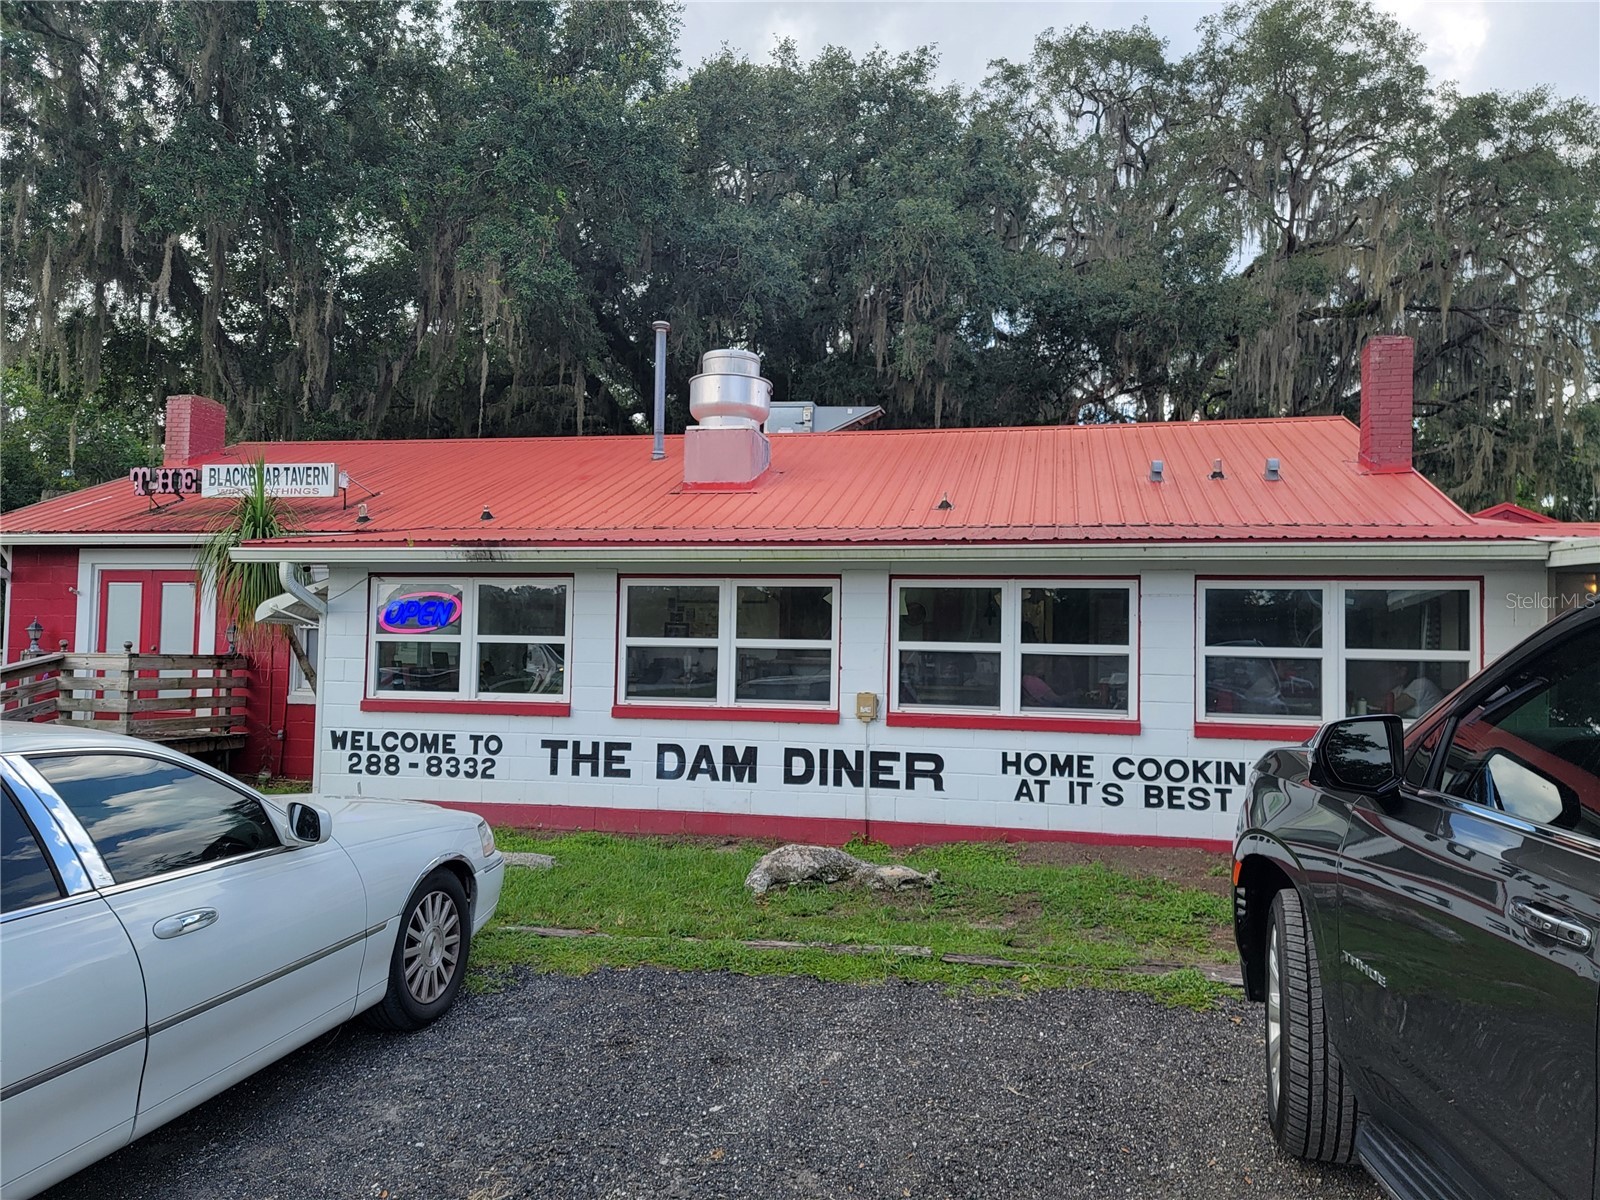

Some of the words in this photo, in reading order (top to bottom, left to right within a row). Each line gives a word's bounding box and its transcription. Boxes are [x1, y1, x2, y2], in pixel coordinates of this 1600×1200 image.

[129, 467, 197, 496] THE
[208, 467, 280, 487] BLACKBAR
[284, 466, 329, 486] TAVERN
[276, 486, 320, 495] THINGS
[384, 600, 454, 627] OPEN
[330, 730, 456, 754] WELCOME
[469, 734, 503, 756] TO
[540, 739, 632, 779] THE
[656, 743, 758, 784] DAM
[783, 747, 945, 792] DINER
[1001, 751, 1094, 779] HOME
[1112, 756, 1252, 786] COOKIN'
[1014, 779, 1050, 803] AT
[1068, 780, 1124, 807] IT'S
[1144, 785, 1232, 812] BEST
[1342, 949, 1386, 989] TAHOE
